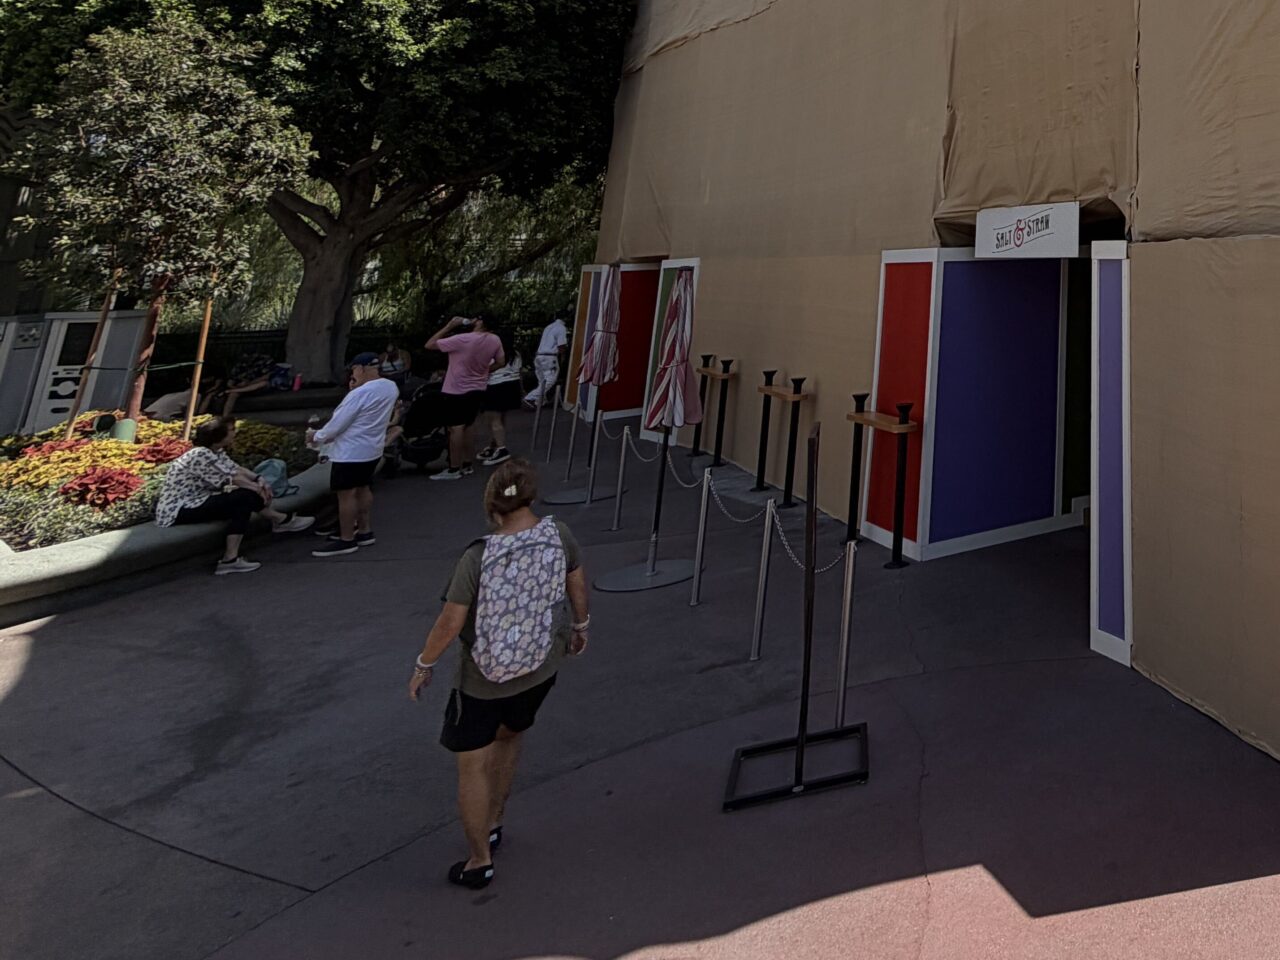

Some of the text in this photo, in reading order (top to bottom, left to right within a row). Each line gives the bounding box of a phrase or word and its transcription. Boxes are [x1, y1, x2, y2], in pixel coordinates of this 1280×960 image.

[996, 214, 1050, 249] SALT & STRAW
